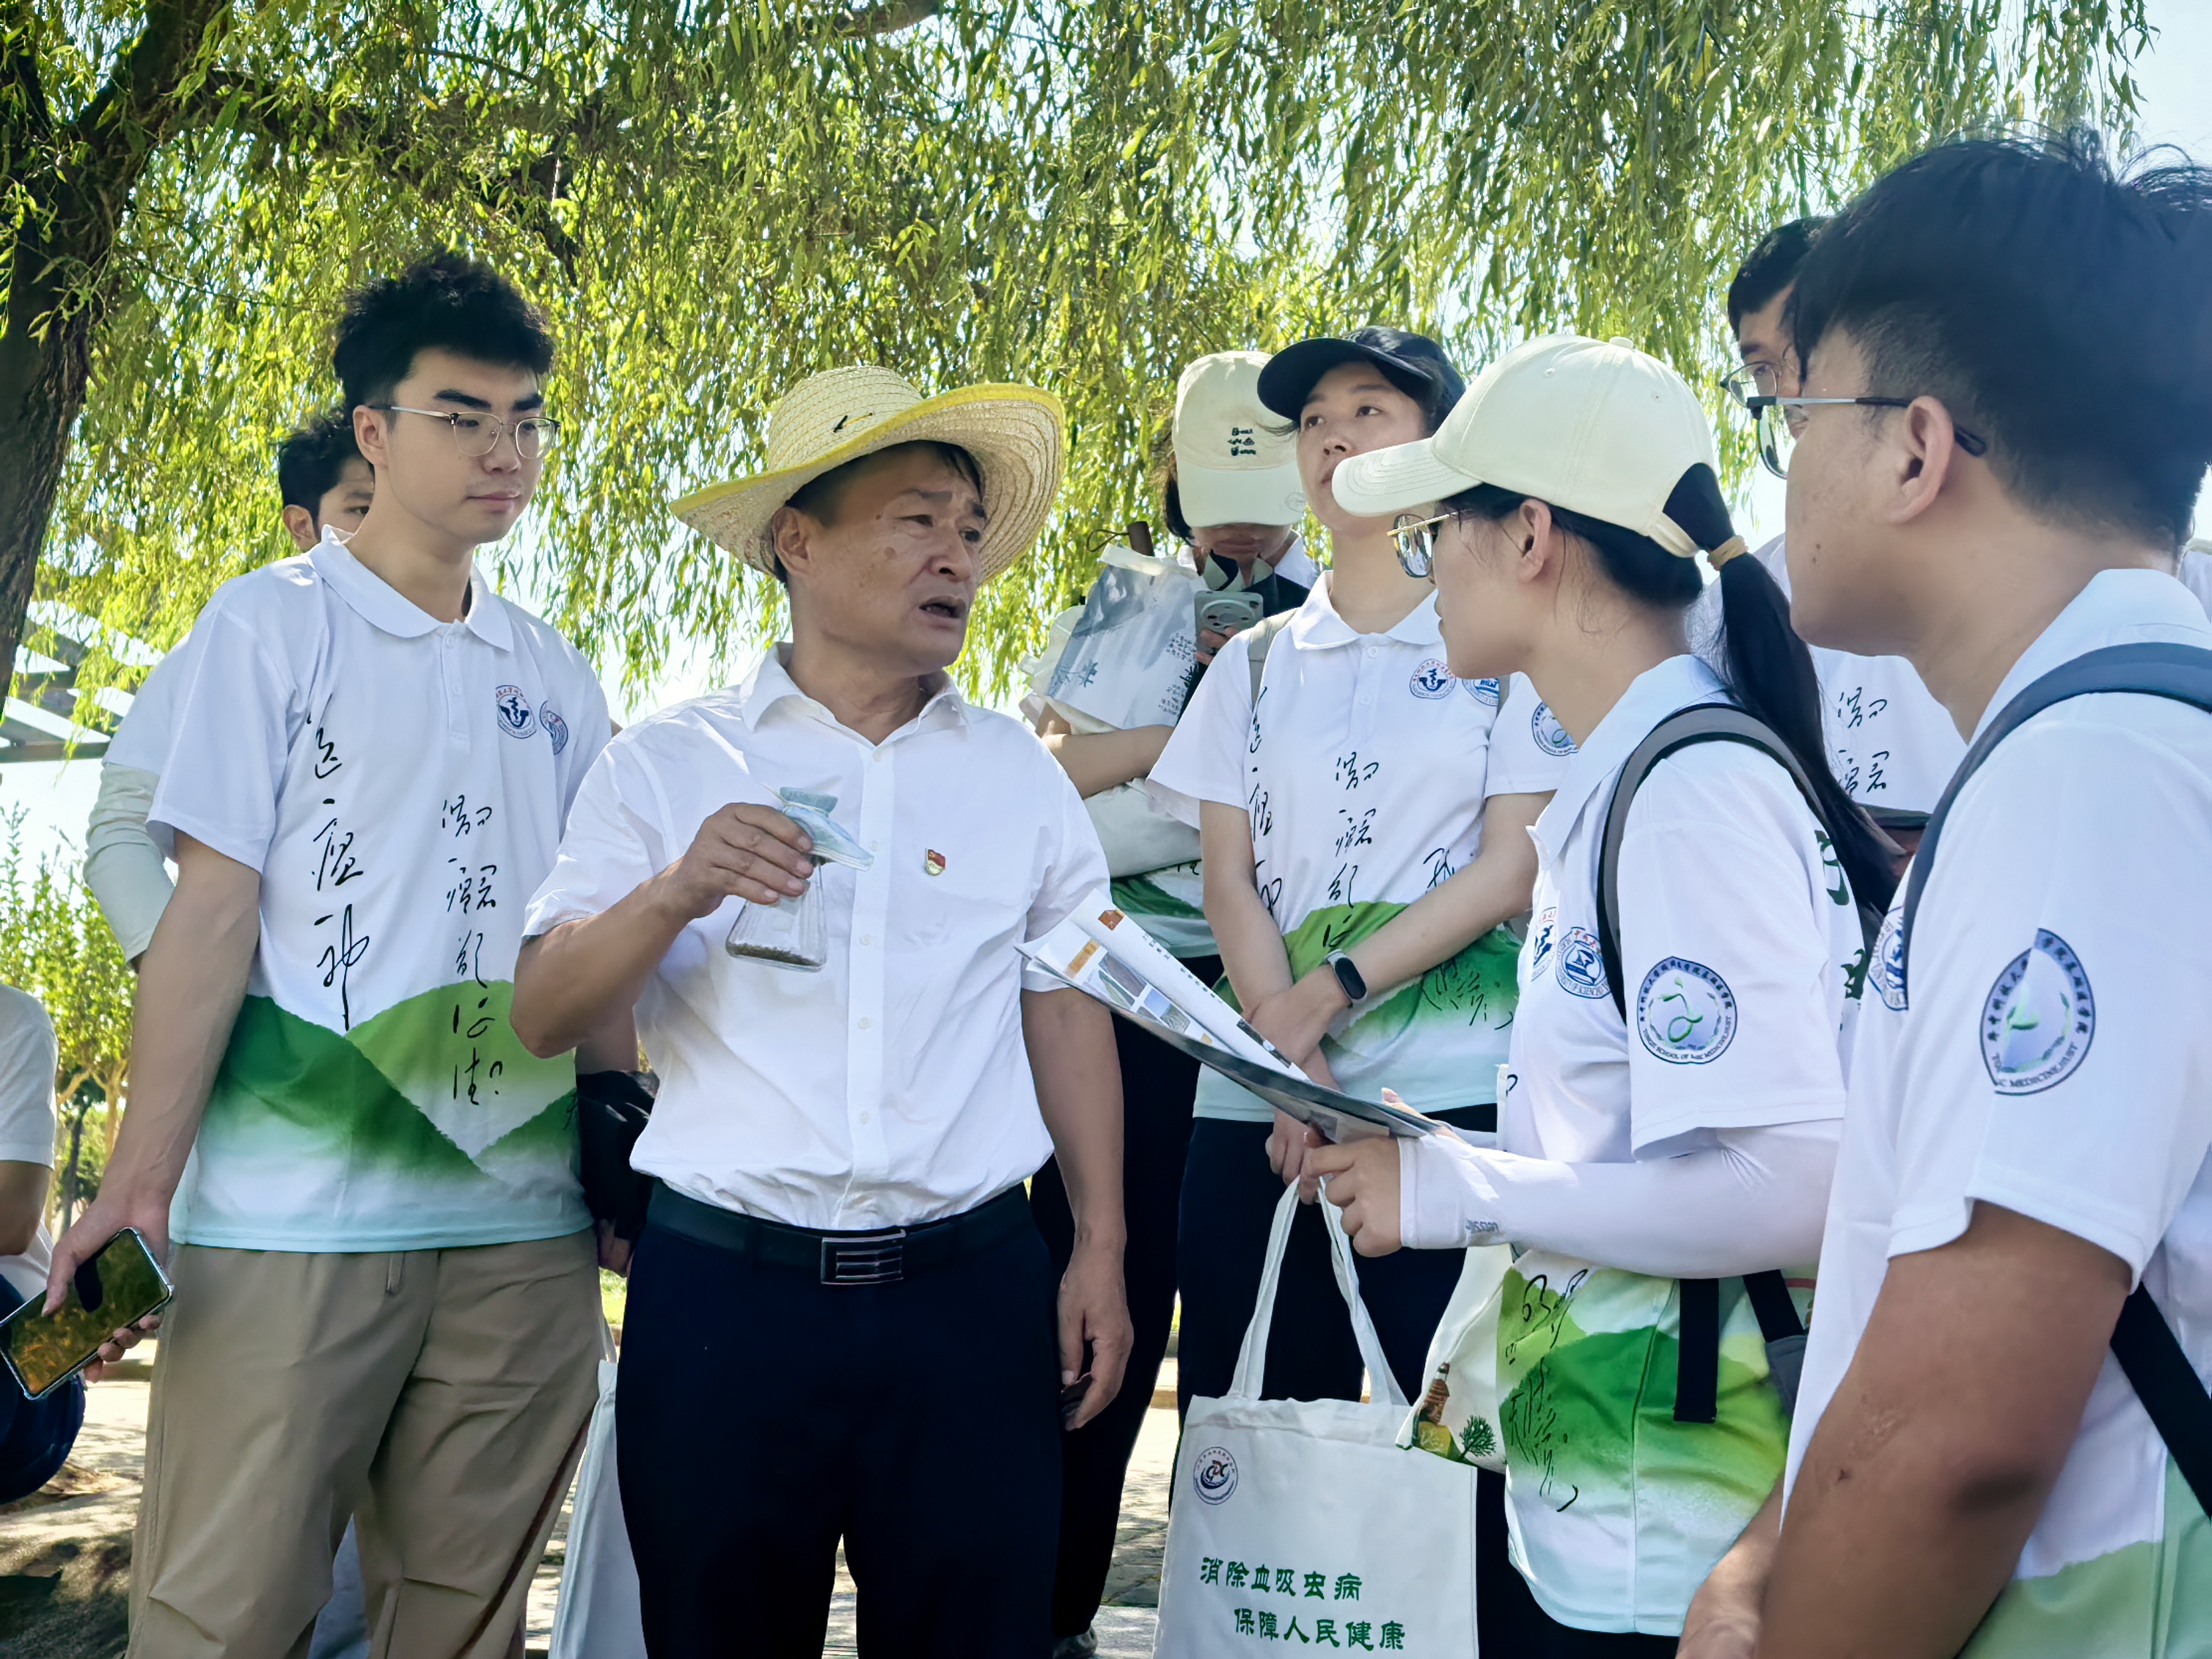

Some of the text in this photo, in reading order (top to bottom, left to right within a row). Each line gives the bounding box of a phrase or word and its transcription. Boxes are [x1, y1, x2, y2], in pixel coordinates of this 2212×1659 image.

[1201, 1557, 1363, 1601] 消除血吸虫病
[1234, 1608, 1406, 1651] 保障人民健康
